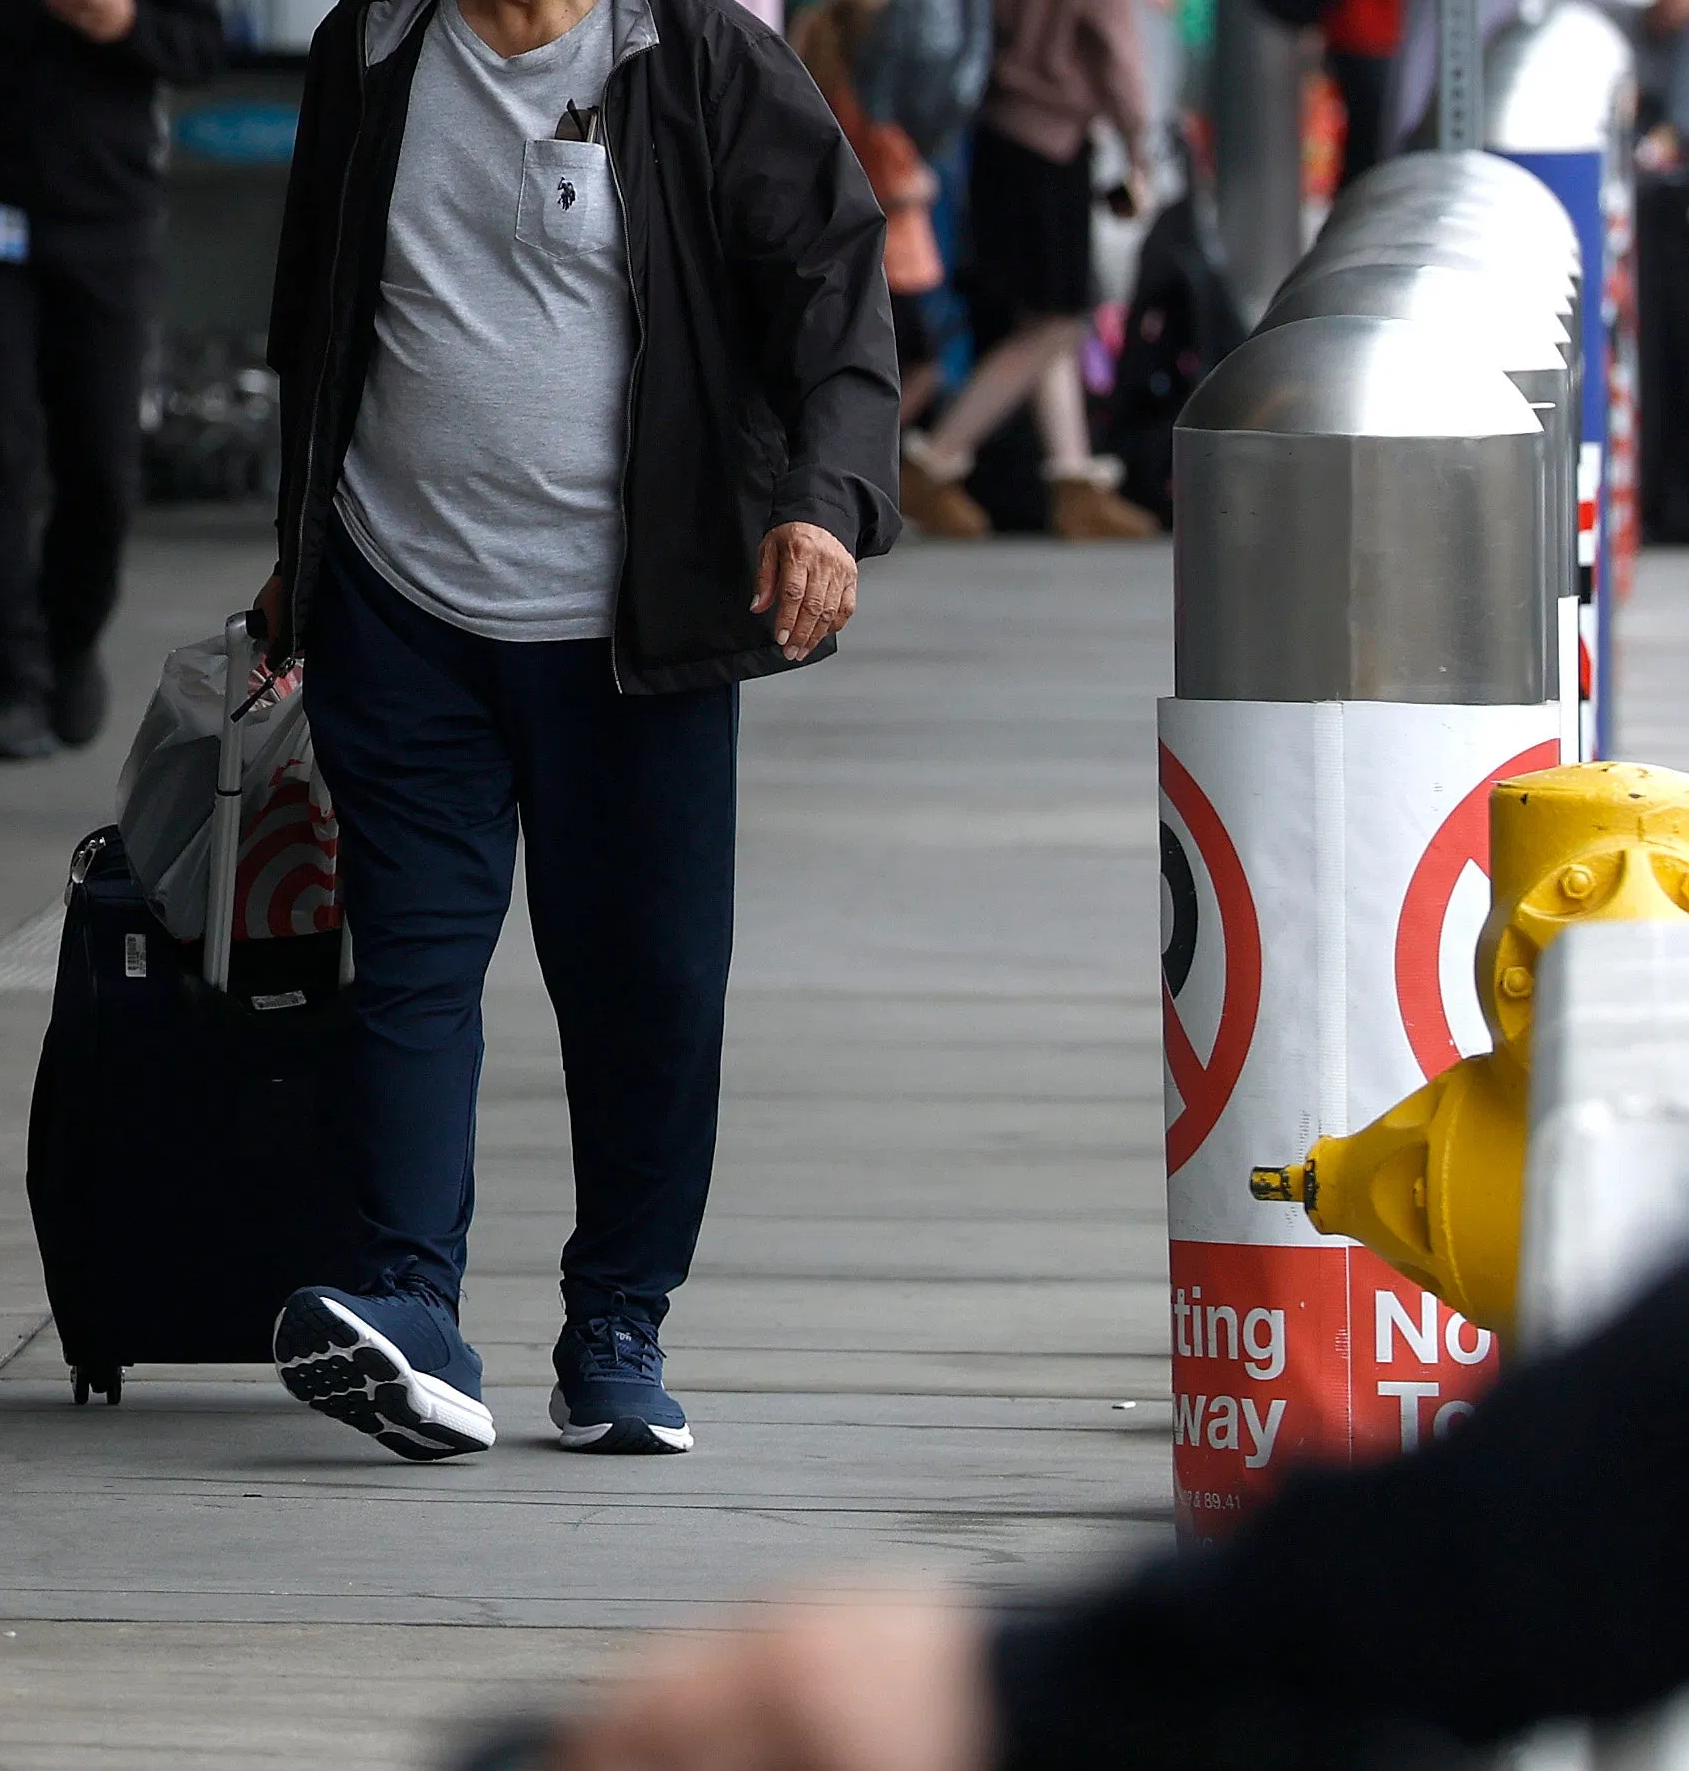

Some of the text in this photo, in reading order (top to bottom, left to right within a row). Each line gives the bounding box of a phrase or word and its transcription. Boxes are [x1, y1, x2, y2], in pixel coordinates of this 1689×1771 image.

[1174, 1286, 1285, 1380] ting
[1375, 1290, 1492, 1365] No
[1173, 1394, 1287, 1468] way
